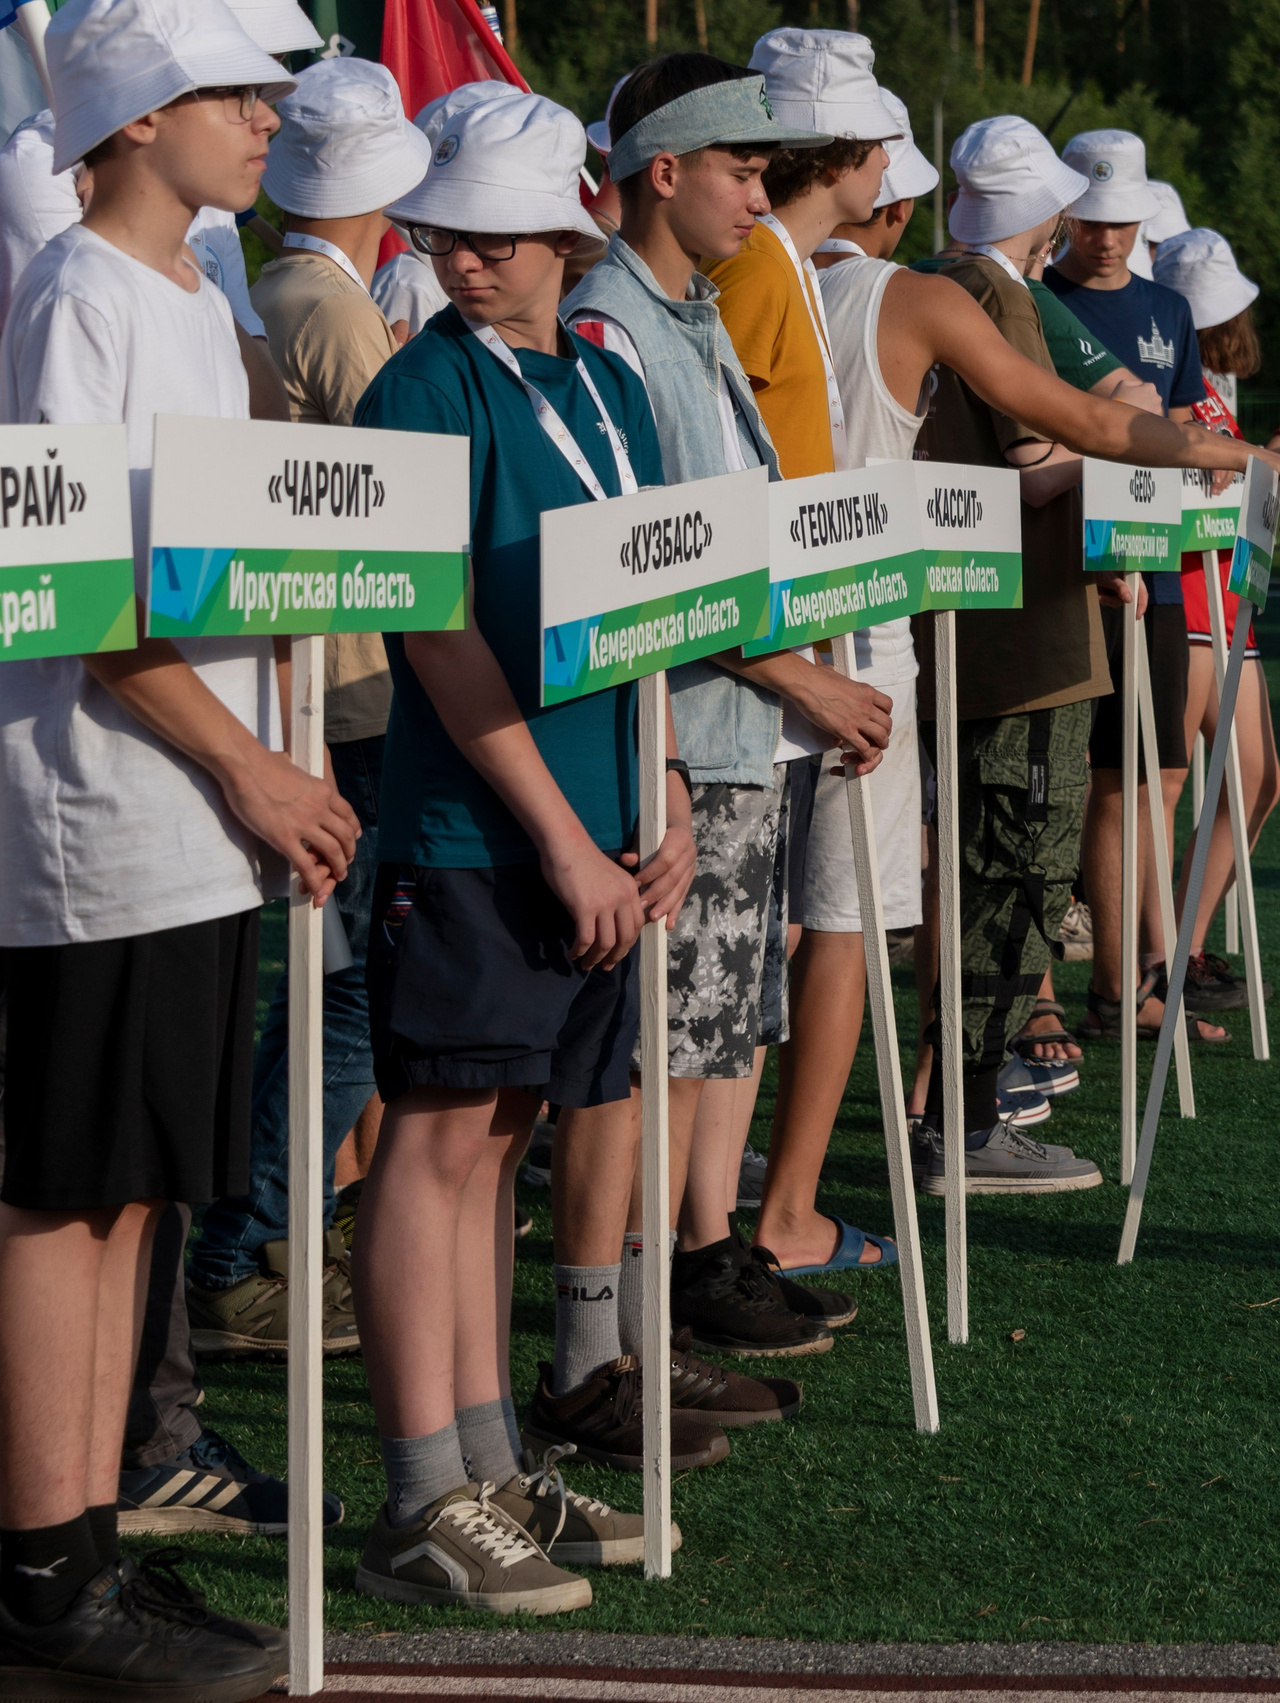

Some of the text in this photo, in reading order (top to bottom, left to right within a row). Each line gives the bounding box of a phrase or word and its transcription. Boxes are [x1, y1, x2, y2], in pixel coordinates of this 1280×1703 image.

[0, 447, 87, 528] РАЙ»
[268, 459, 386, 518] «ЧАРОИТ»
[926, 487, 983, 529] «КАССИТ»
[1129, 469, 1156, 504] «GEOS»
[620, 510, 713, 576] «КУЗБАСС»
[790, 492, 889, 550] «ГЕОКЛУБ НК»
[1111, 527, 1169, 564] Красноярский край
[1195, 519, 1204, 539] г.
[1202, 513, 1235, 539] Москва
[228, 559, 416, 622] Иркутская область
[781, 567, 909, 630] Кемеровская область
[964, 557, 1000, 593] область
[0, 573, 57, 648] рай
[589, 594, 740, 671] Кемеровская область
[557, 1285, 614, 1301] FILA
